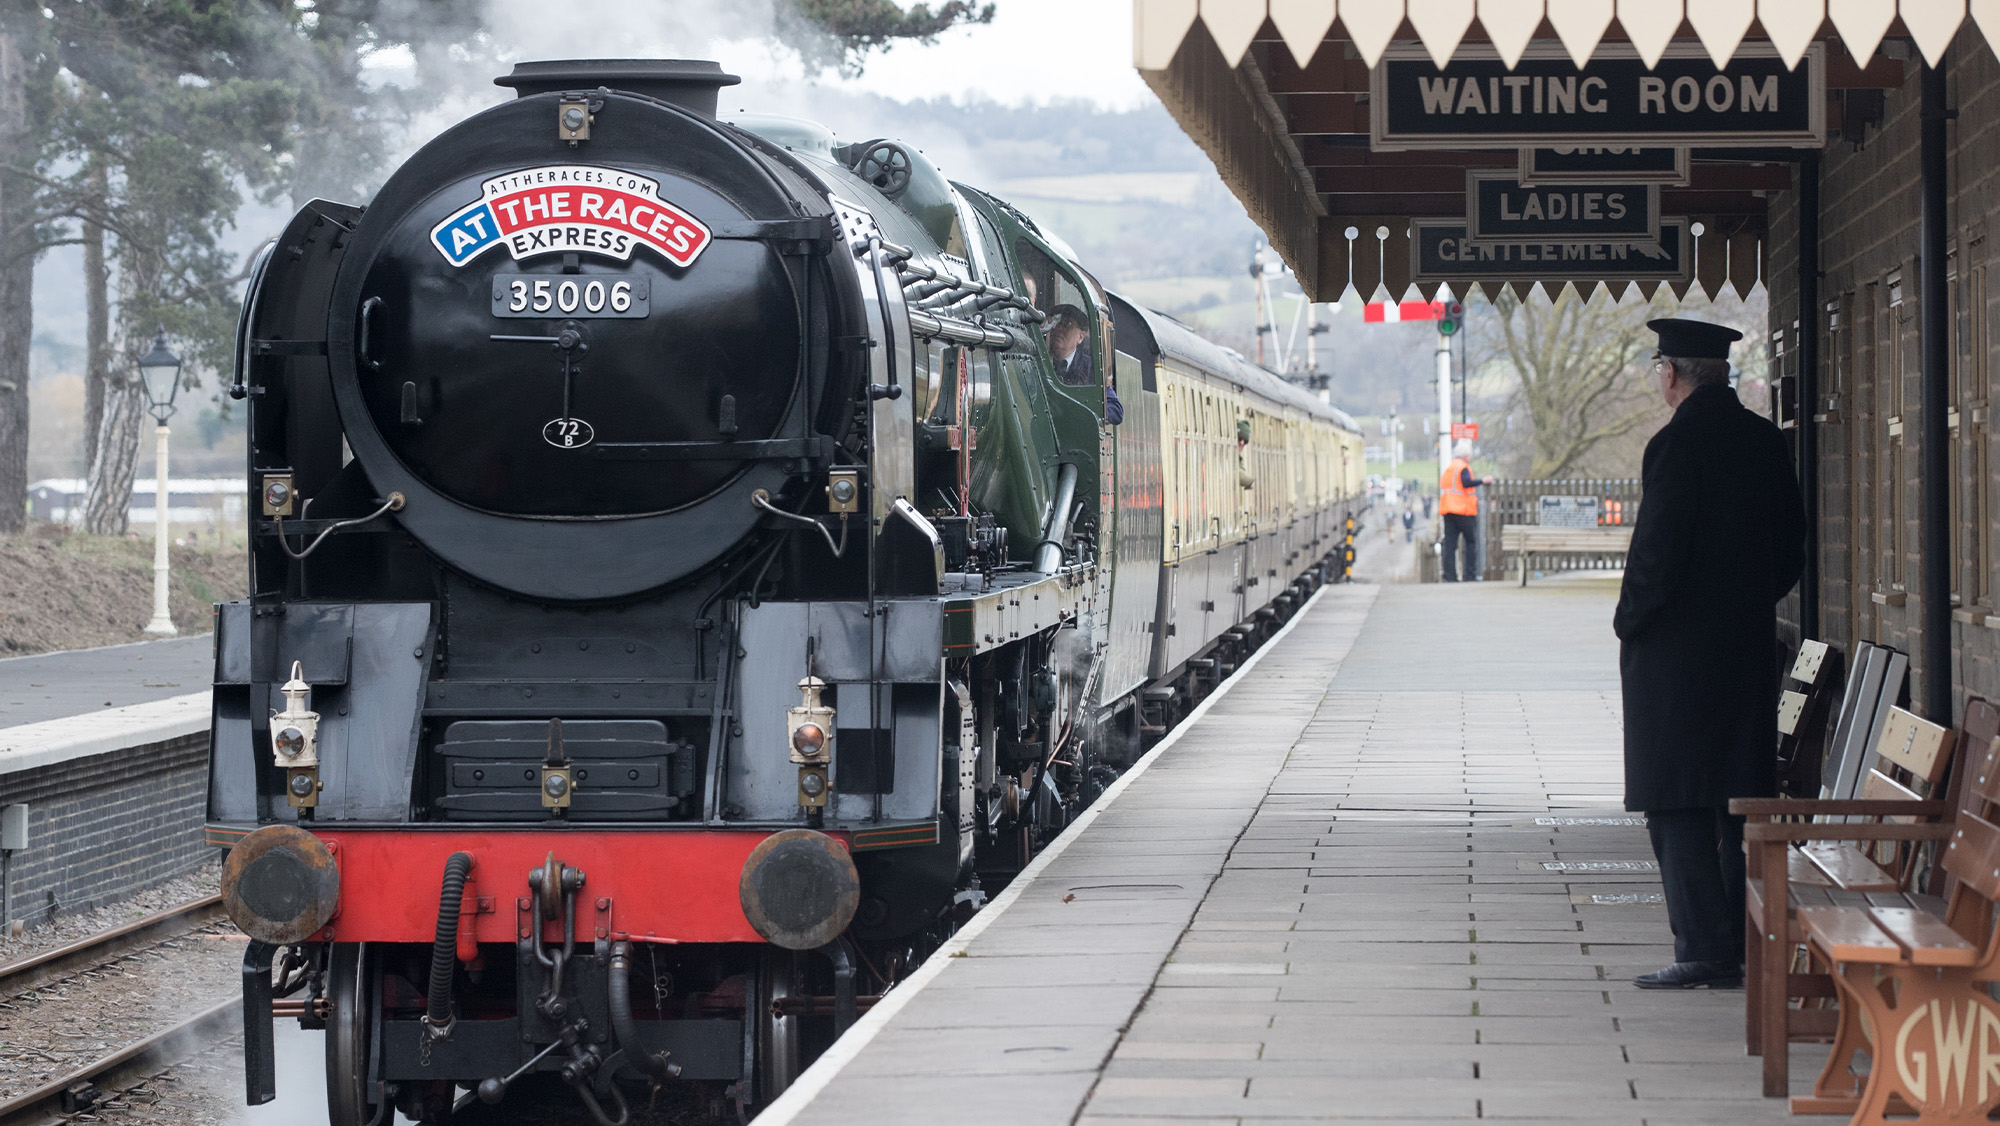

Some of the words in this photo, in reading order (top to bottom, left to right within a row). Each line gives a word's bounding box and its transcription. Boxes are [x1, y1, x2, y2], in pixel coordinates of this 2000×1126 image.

[1418, 76, 1608, 115] WAITING
[1639, 75, 1779, 113] ROOM
[490, 170, 652, 195] ATTHERACES.COM
[1500, 193, 1627, 221] LADIES
[452, 213, 486, 256] AT
[498, 192, 571, 226] THE
[579, 192, 697, 253] RACES
[511, 227, 630, 255] EXPRESS
[1438, 238, 1628, 261] GENTLEMEN
[509, 280, 633, 313] 35006
[558, 421, 579, 436] 72
[564, 434, 574, 447] B
[1895, 998, 2000, 1107] GWR
